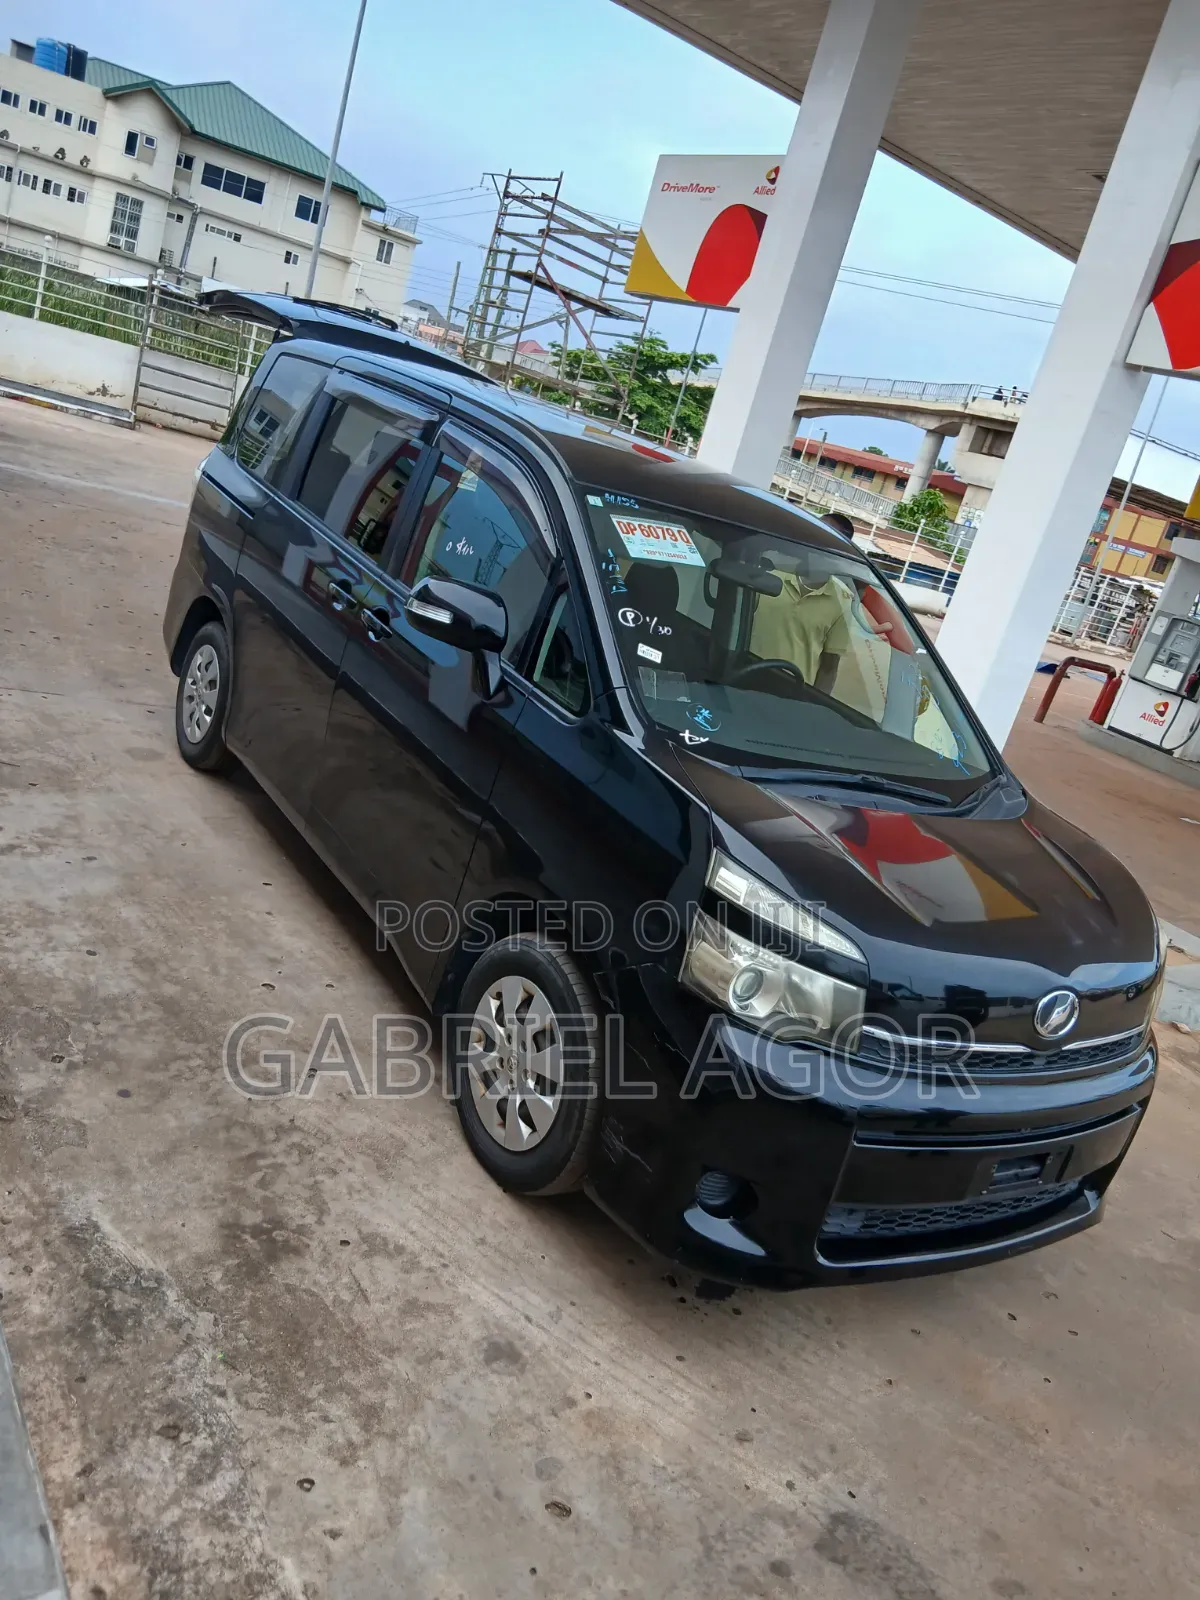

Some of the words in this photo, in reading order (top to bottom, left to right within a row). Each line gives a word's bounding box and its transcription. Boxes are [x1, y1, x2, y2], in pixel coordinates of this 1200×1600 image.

[661, 182, 715, 194] DriveMore
[753, 186, 776, 195] Allied
[615, 520, 637, 536] DP
[637, 523, 678, 543] 6079
[1139, 712, 1166, 727] Allied
